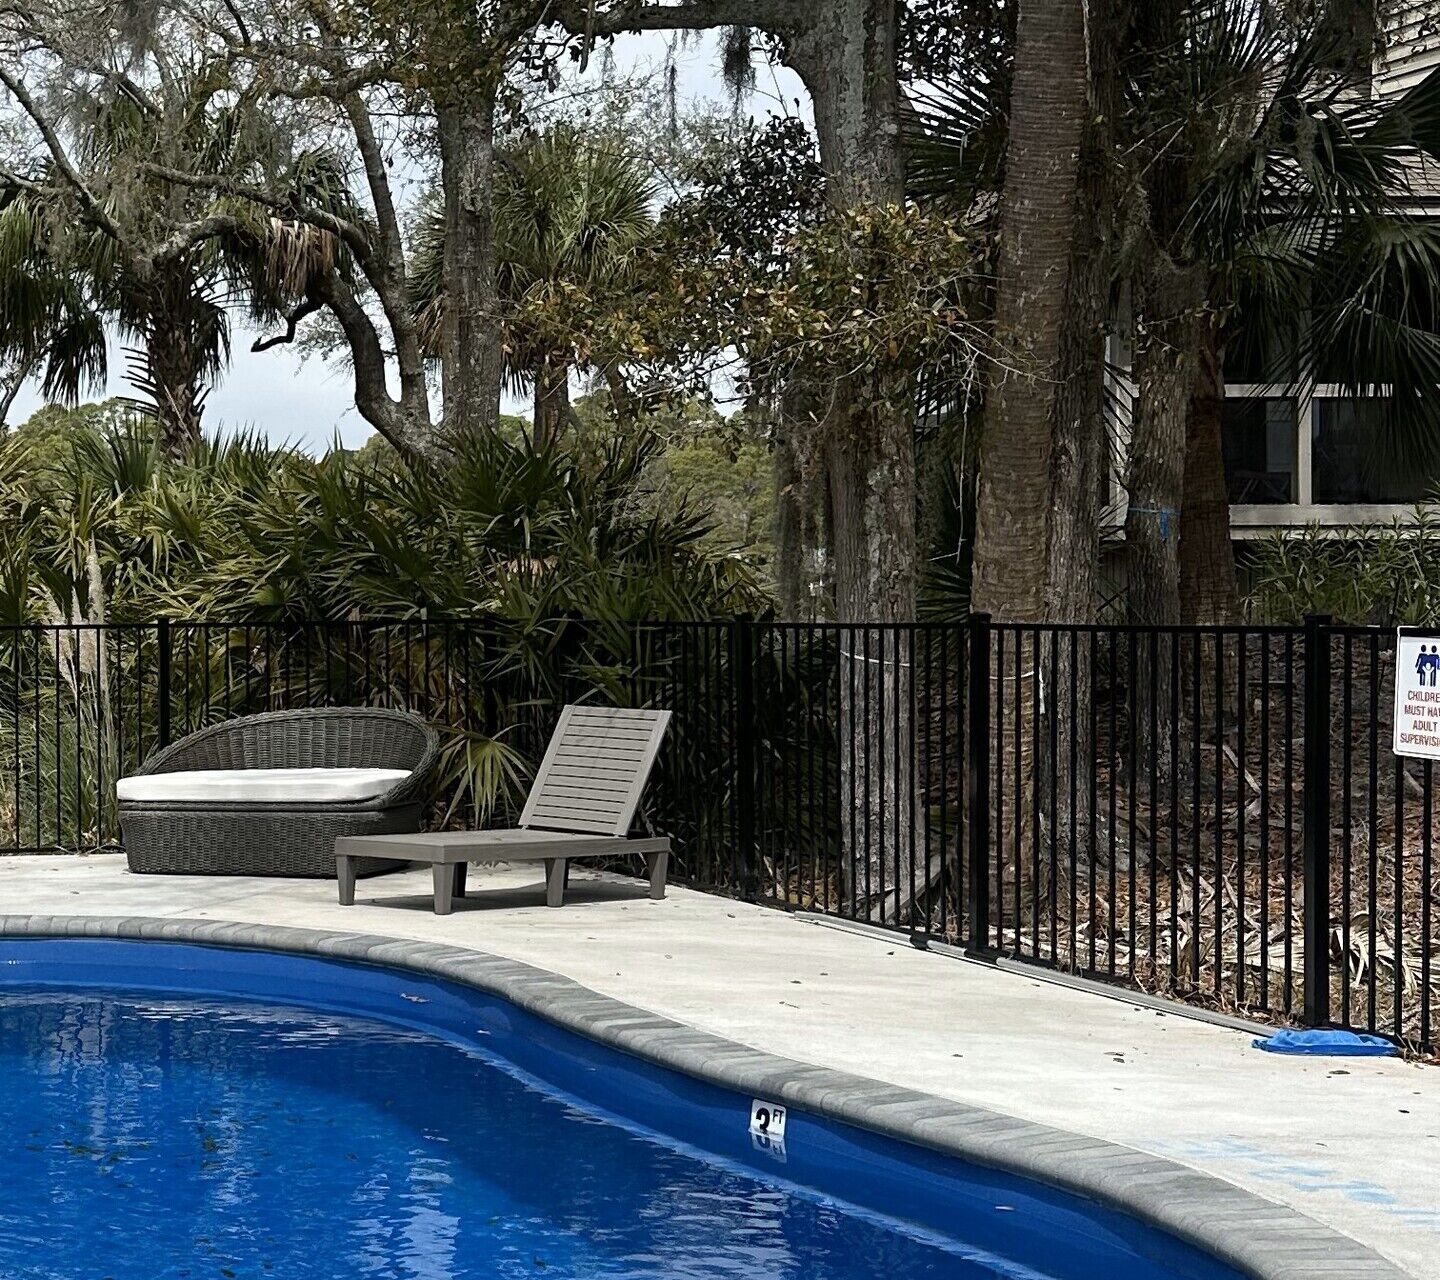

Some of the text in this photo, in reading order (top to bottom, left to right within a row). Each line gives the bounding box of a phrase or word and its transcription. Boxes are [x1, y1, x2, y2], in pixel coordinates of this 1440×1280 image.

[1408, 690, 1440, 703] CHILDRE
[1404, 705, 1440, 717] MUST HA
[1413, 720, 1437, 732] ADULT
[1400, 733, 1440, 747] SUPERVISI
[772, 1108, 785, 1125] FT
